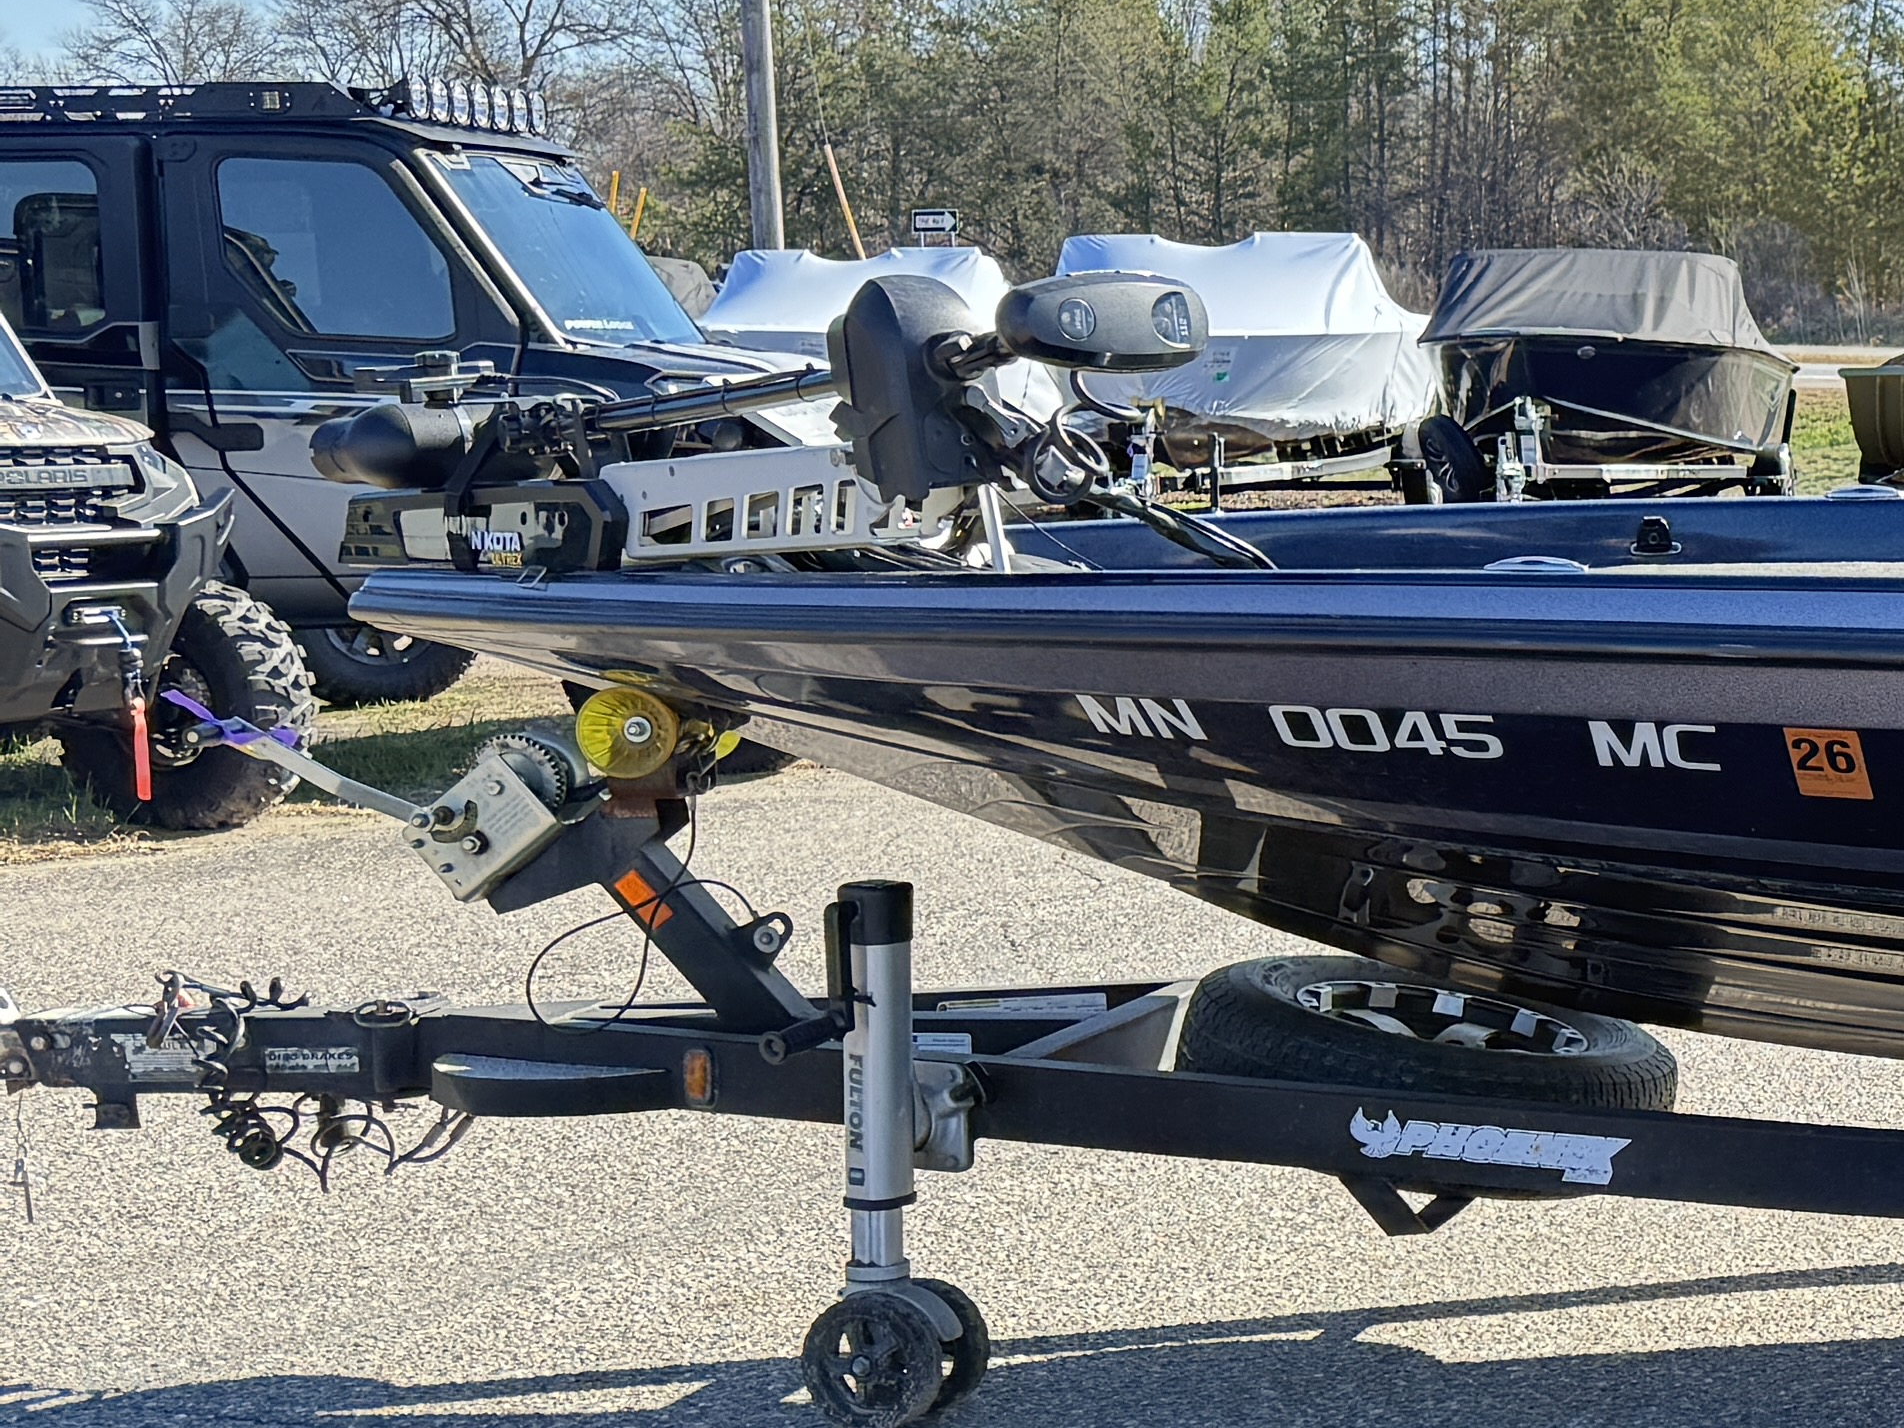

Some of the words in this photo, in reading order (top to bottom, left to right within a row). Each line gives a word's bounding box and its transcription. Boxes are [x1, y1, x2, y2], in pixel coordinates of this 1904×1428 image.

[0, 468, 88, 485] OLARIS
[483, 531, 521, 551] KOTA
[1074, 694, 1208, 741] MN
[1268, 704, 1504, 759] 0045
[1587, 720, 1722, 771] MC
[1791, 737, 1857, 774] 26
[849, 1053, 864, 1153] FULTON
